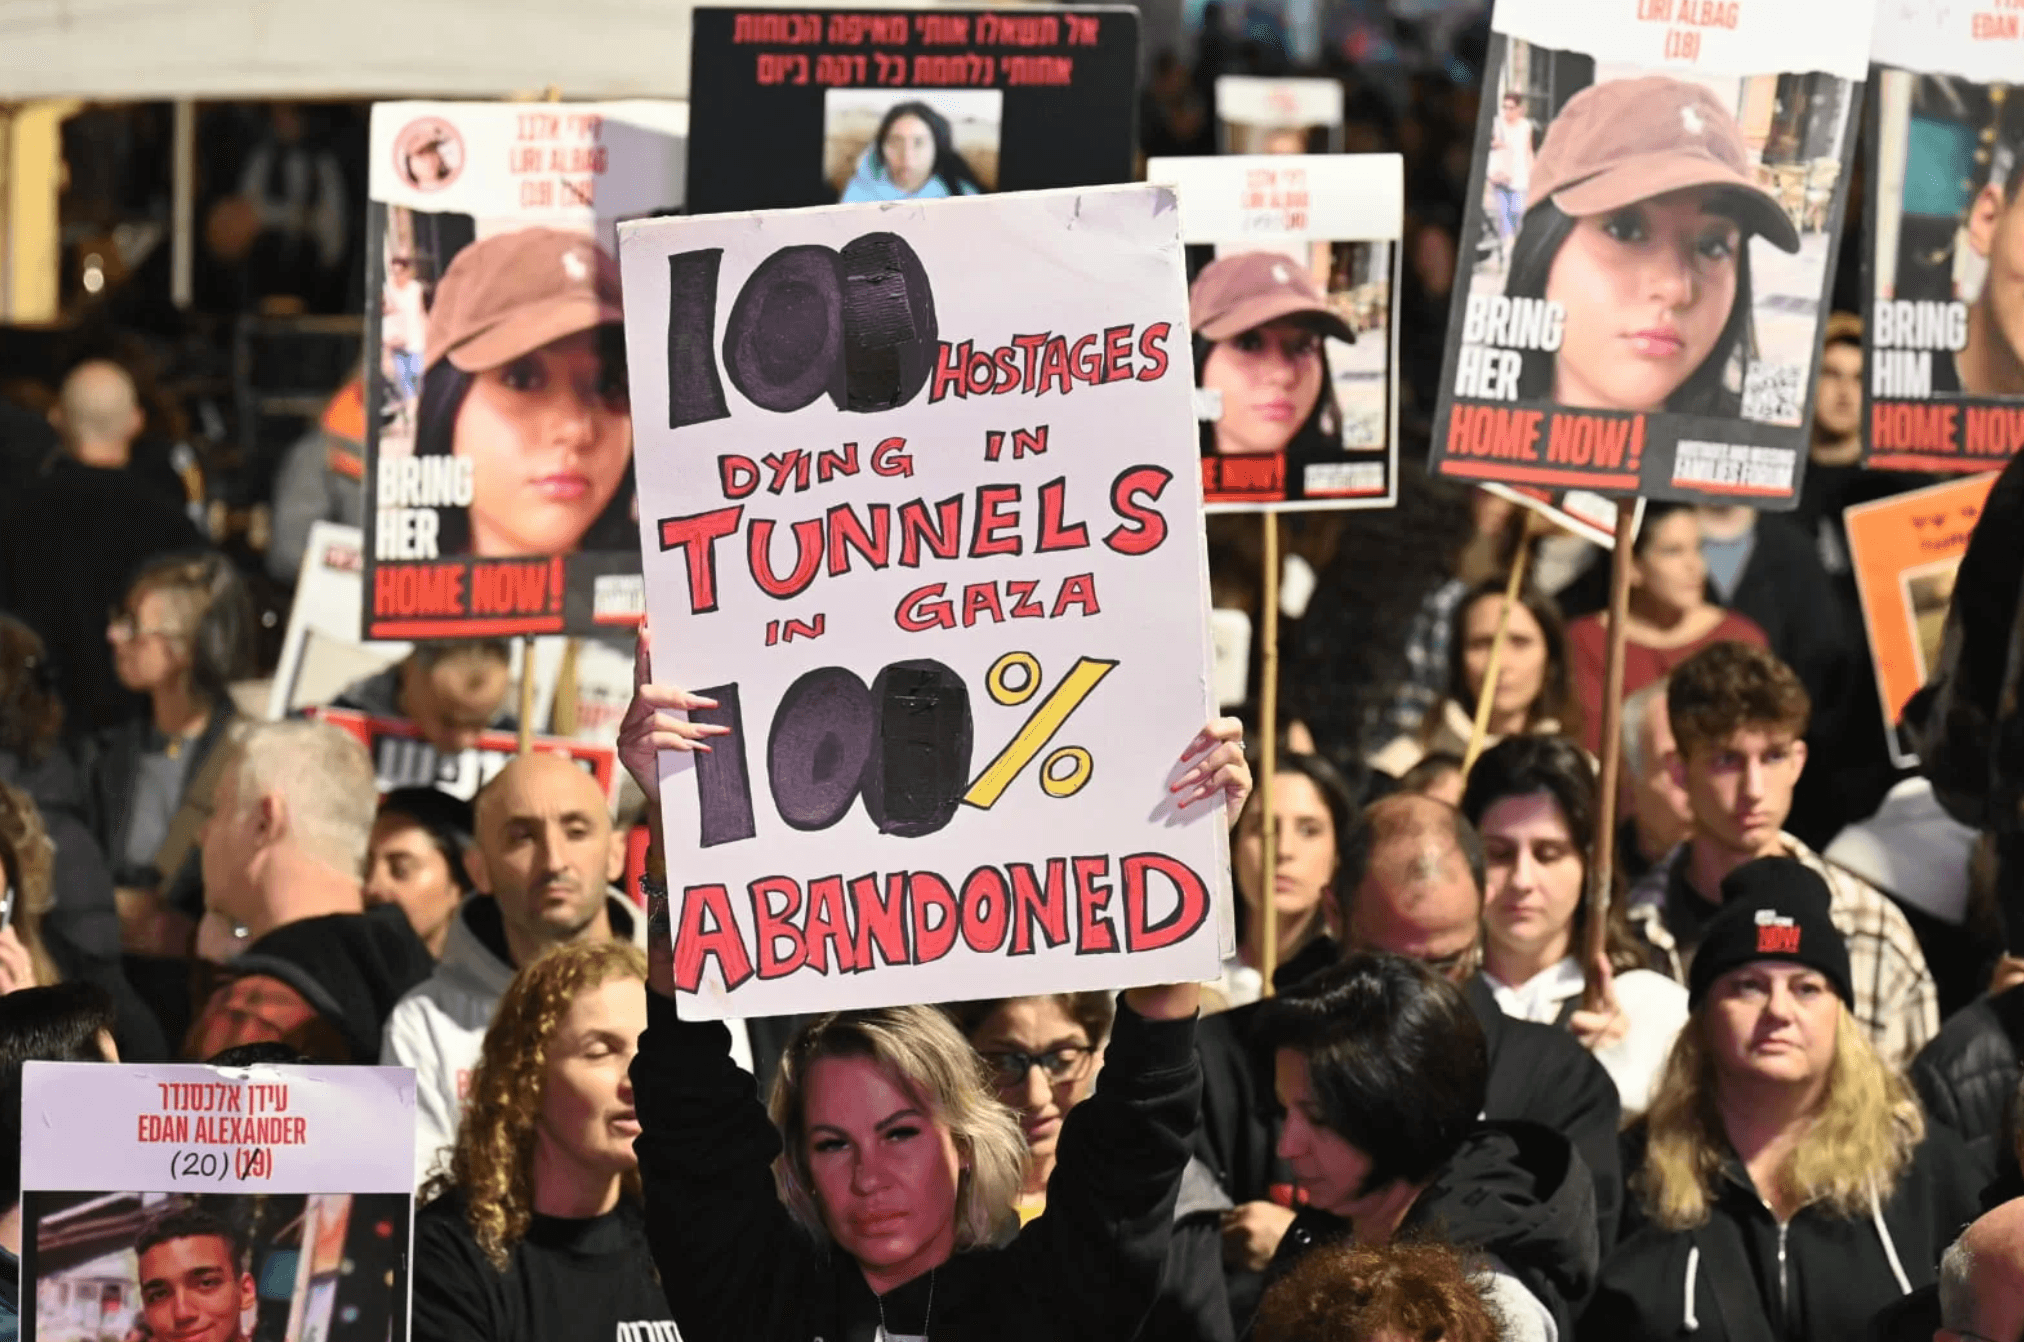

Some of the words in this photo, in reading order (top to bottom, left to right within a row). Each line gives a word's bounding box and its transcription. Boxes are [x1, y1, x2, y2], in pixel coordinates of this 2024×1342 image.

[668, 231, 938, 429] 100
[928, 322, 1172, 406] HOSTAGES
[1462, 293, 1567, 351] BRING
[1873, 299, 1968, 350] BRING
[1454, 347, 1522, 401] HER
[1872, 350, 1932, 398] HIM
[1447, 403, 1544, 461] HOME
[1546, 413, 1646, 471] NOW!
[1872, 402, 1959, 450] HOME
[378, 455, 473, 506] BRING
[719, 437, 914, 499] DYING
[985, 425, 1048, 461] IN
[376, 508, 439, 560] HER
[658, 465, 1173, 615] TUNNELS
[375, 563, 465, 617] HOME
[471, 555, 564, 615] NOW!
[765, 613, 825, 645] IN
[895, 573, 1100, 632] GAZA
[688, 651, 1119, 848] 100%
[673, 853, 1210, 993] ABANDONED
[158, 1082, 241, 1112] אלכסנדר
[248, 1084, 288, 1116] עידן
[138, 1115, 188, 1142] EDAN
[195, 1116, 307, 1145] ALEXANDER
[171, 1150, 229, 1181] (20)
[235, 1147, 273, 1180] (19)
